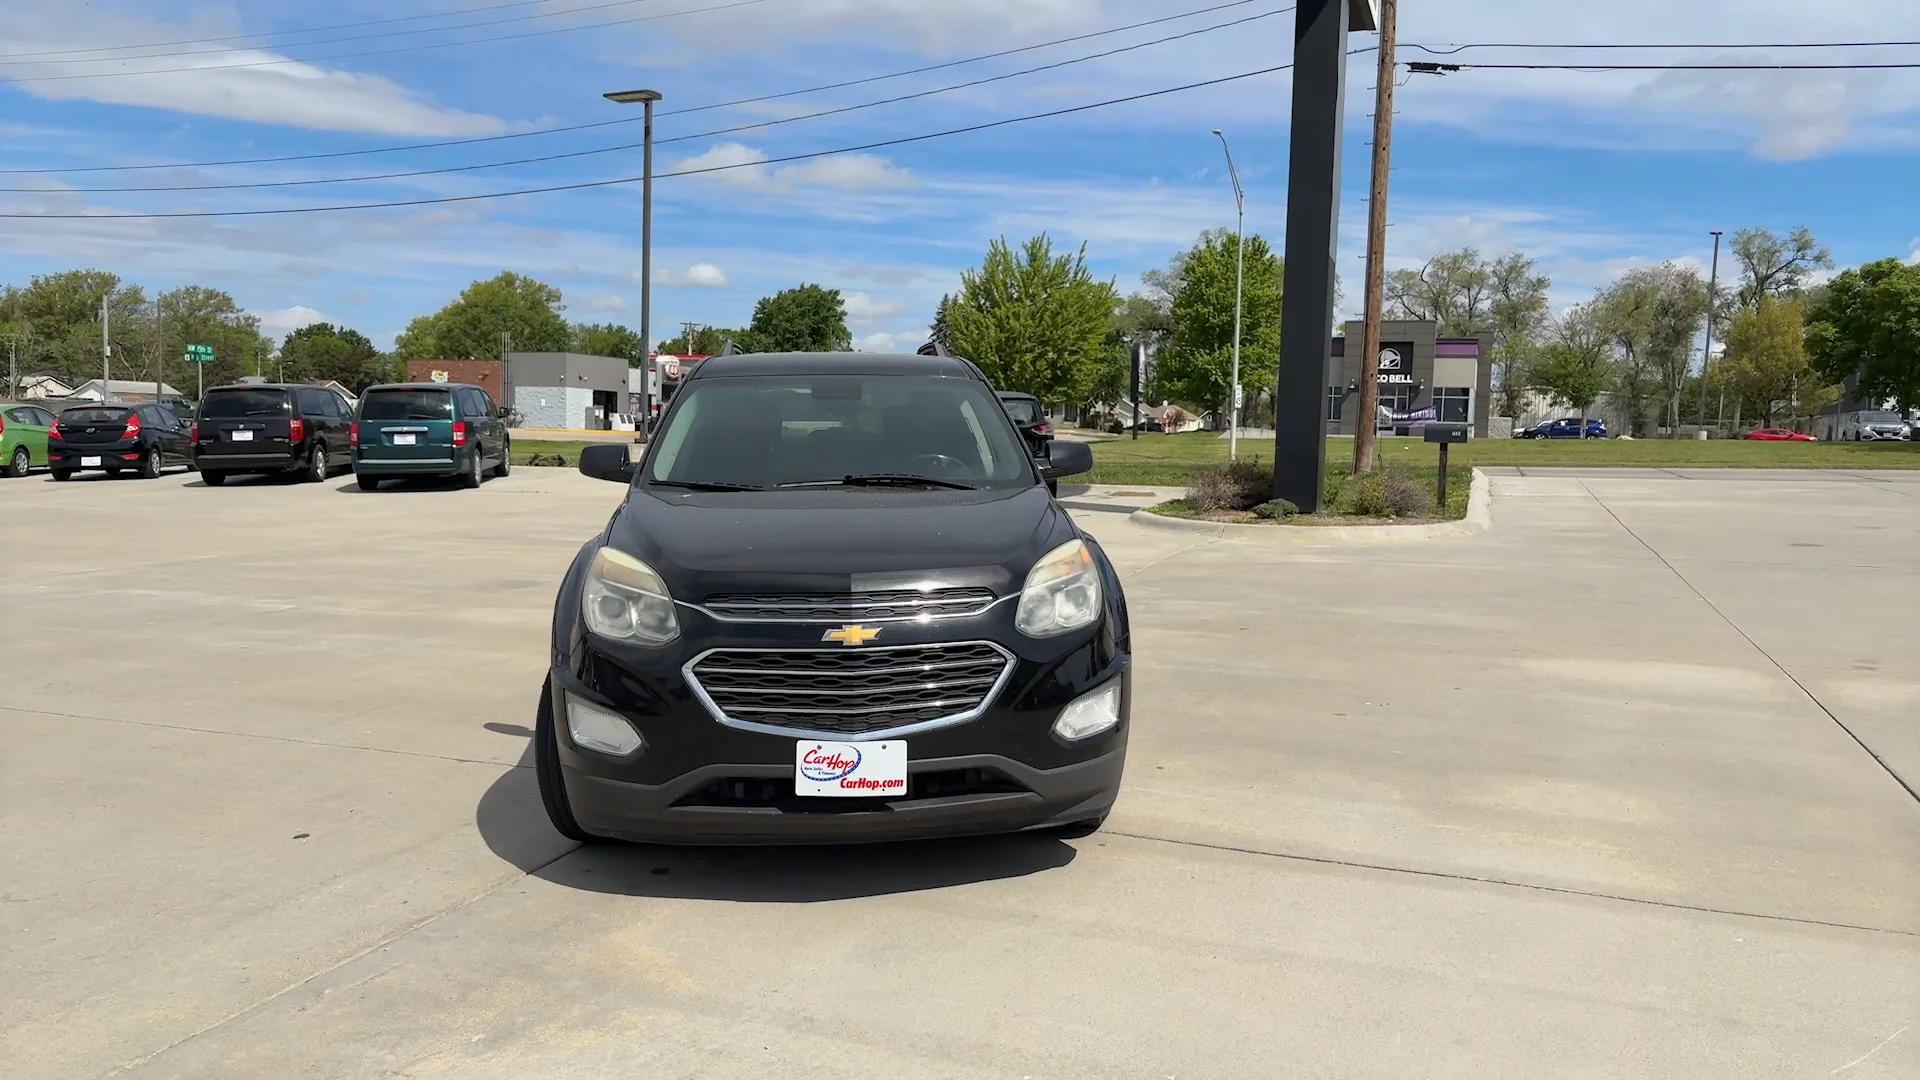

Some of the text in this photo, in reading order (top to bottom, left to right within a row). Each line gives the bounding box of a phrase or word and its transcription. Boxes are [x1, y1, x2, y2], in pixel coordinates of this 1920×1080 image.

[1389, 374, 1413, 383] BELL
[803, 749, 855, 776] CarHop
[840, 777, 904, 790] CarHop.com
